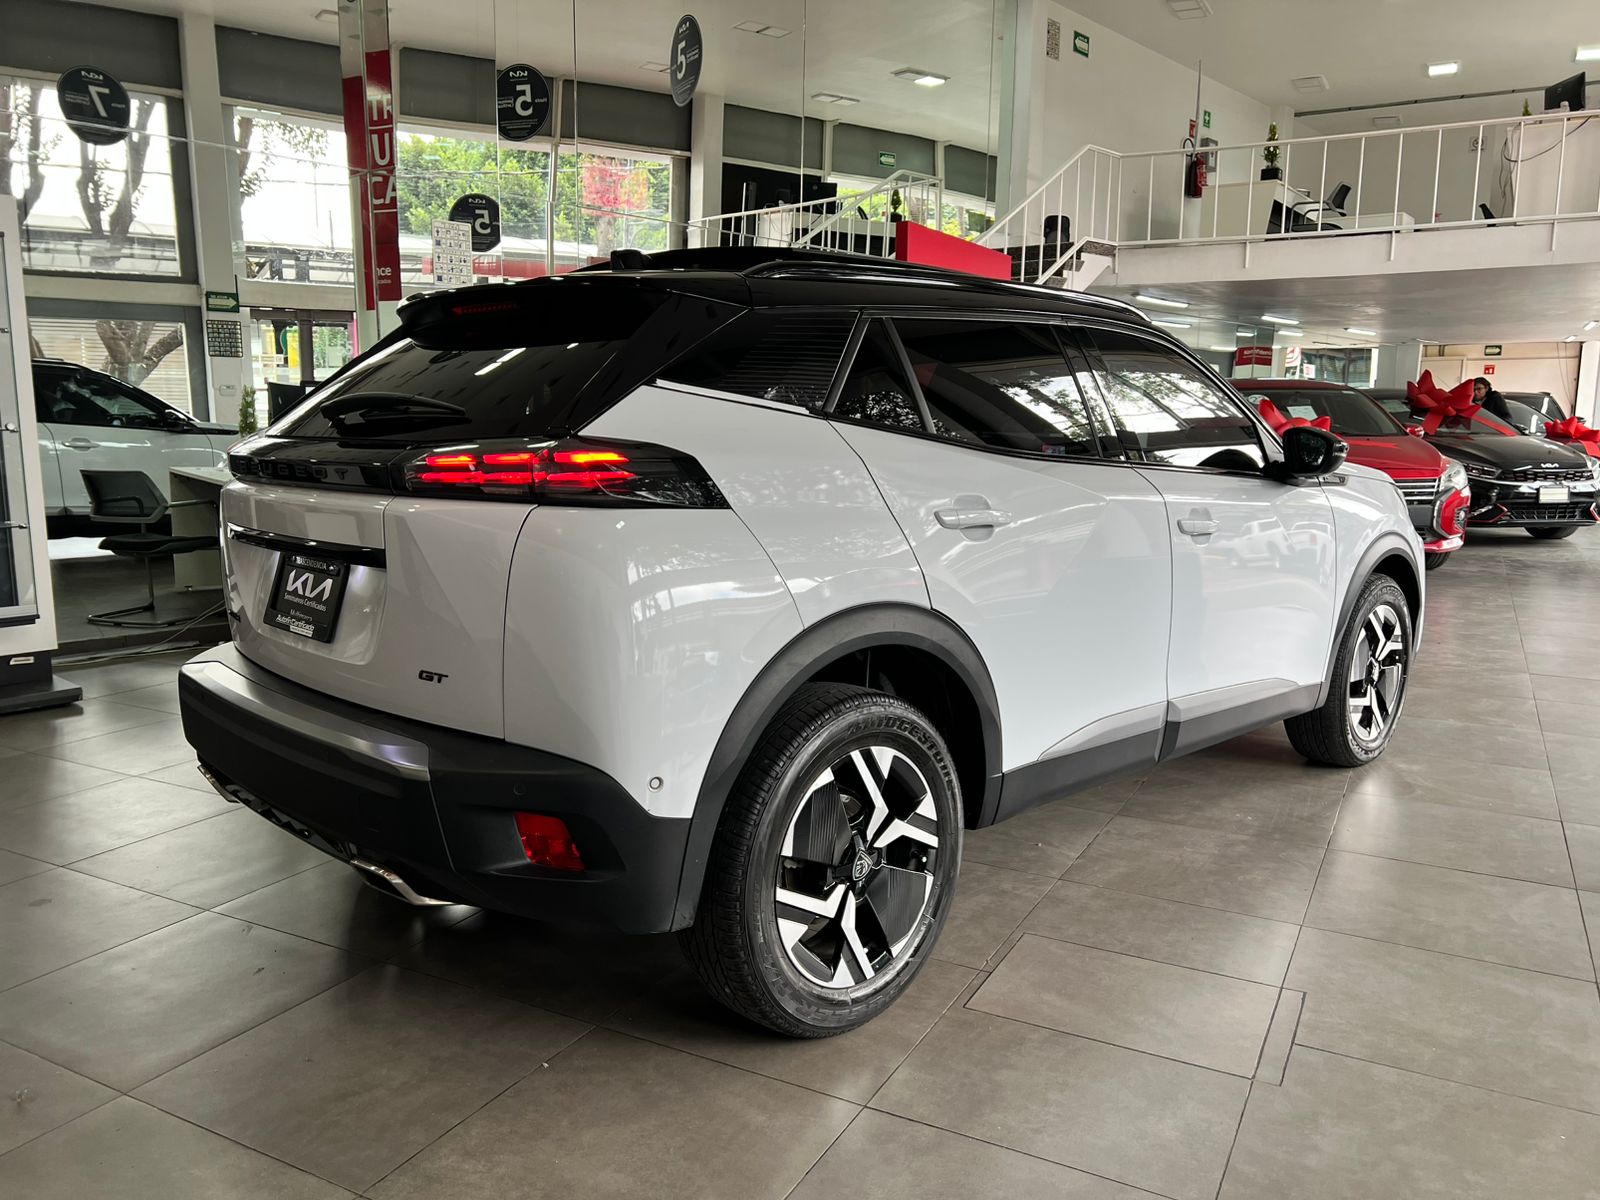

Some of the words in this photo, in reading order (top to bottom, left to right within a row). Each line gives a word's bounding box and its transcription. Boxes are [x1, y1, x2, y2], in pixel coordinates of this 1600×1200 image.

[677, 40, 686, 80] 5
[286, 569, 333, 602] KIA
[418, 669, 448, 684] GT
